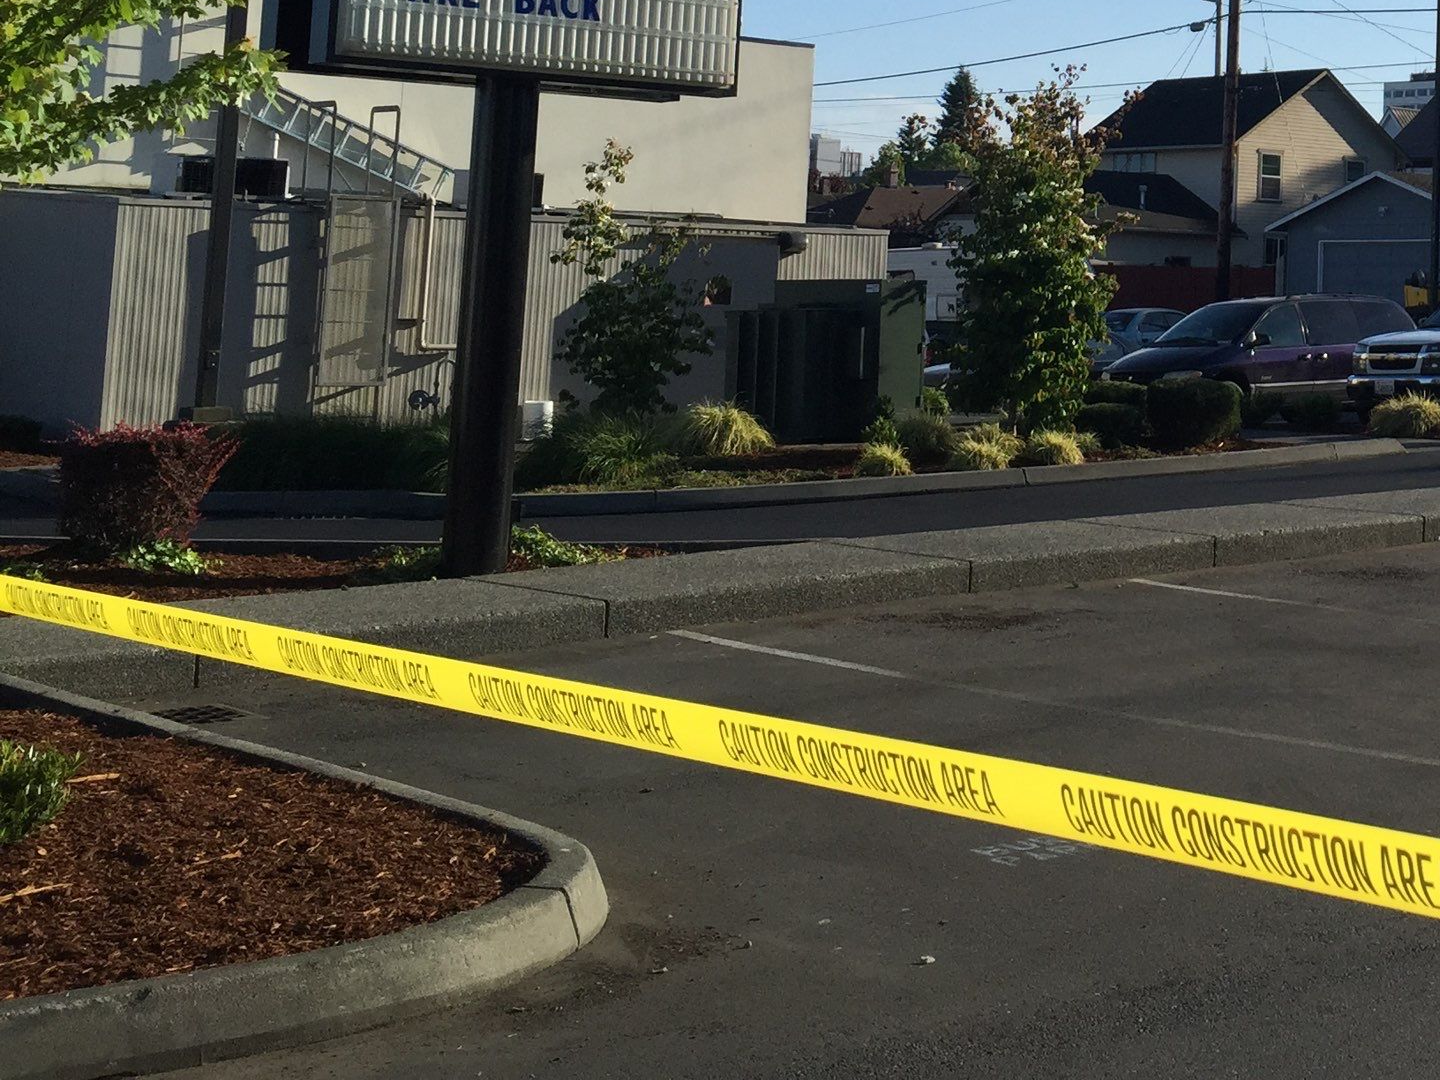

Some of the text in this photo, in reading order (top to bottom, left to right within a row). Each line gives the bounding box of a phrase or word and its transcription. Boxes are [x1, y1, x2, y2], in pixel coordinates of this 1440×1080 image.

[127, 607, 258, 661] CAUTION CONSTRUCTION AREA
[277, 635, 442, 701] CAUTION CONSTRUCTION AREA
[468, 672, 682, 750] CAUTION CONSTRUCTION AREA
[719, 719, 1006, 817] CAUTION CONSTRUCTION AREA
[1061, 784, 1174, 853] CAUTION
[1171, 806, 1379, 896] CONSTRUCTION
